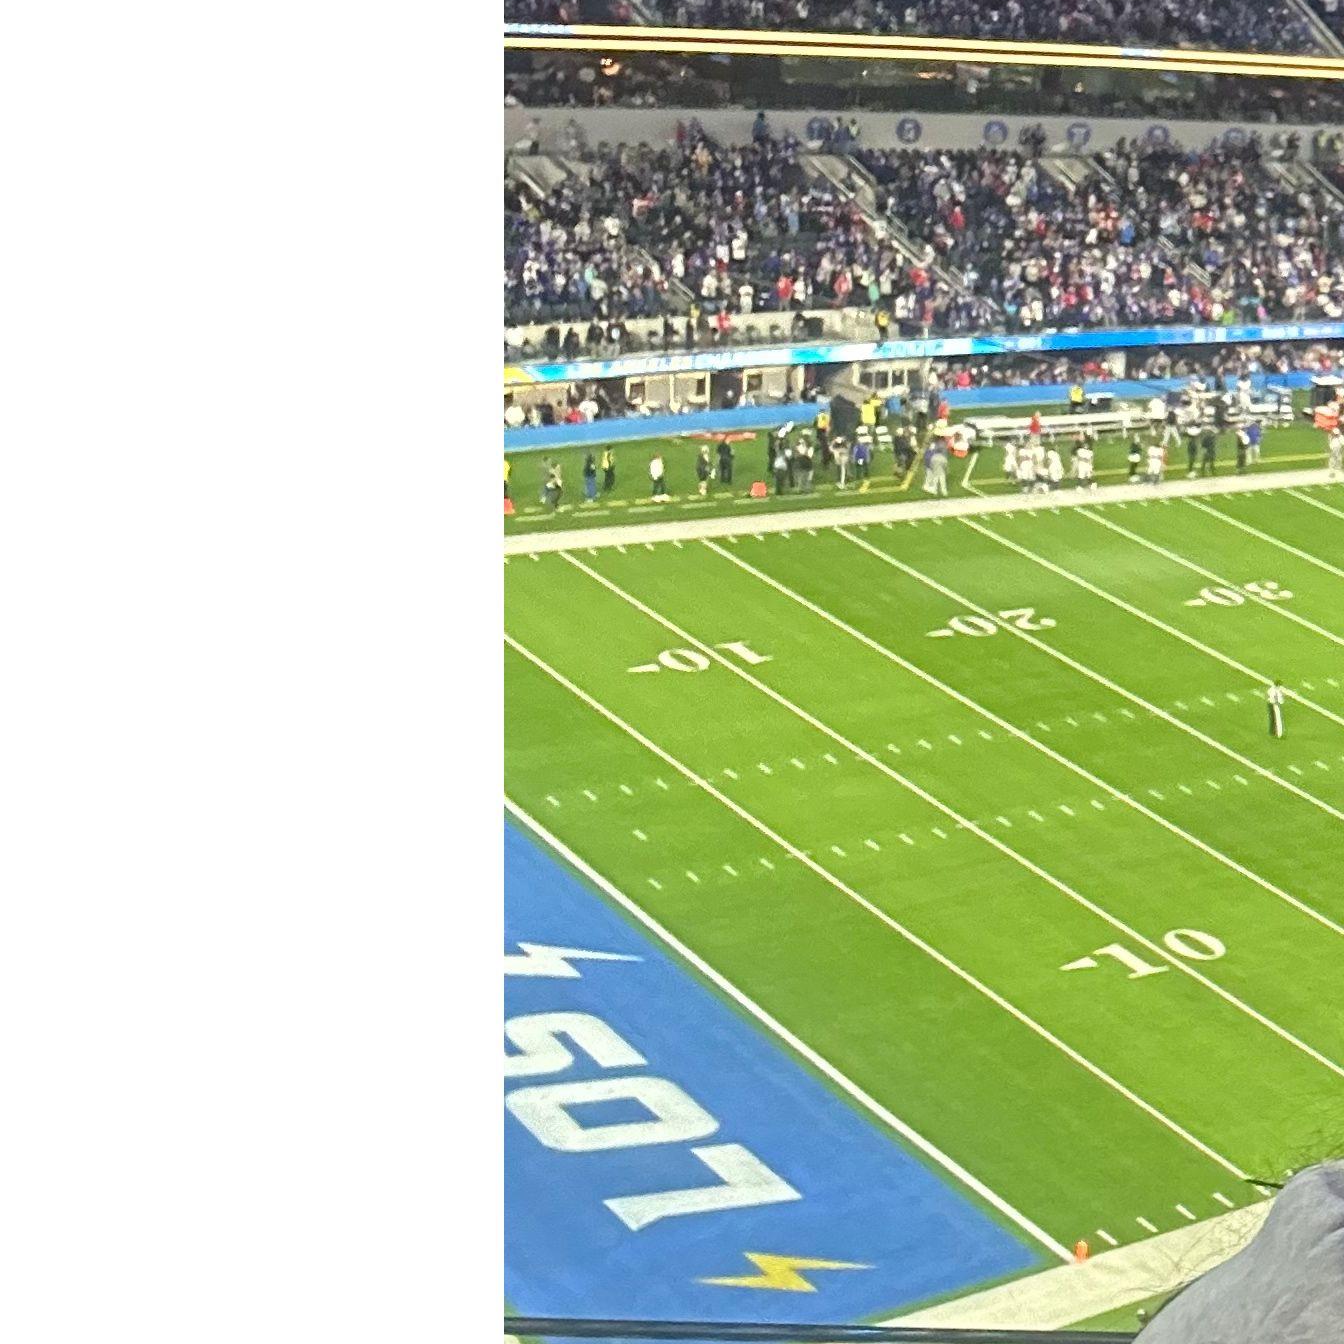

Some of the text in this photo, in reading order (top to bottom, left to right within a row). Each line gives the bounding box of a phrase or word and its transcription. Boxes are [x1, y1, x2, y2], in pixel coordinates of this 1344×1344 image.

[1200, 580, 1293, 608] 30
[946, 606, 1057, 638] 20
[657, 640, 774, 673] 10
[1093, 927, 1227, 980] 10
